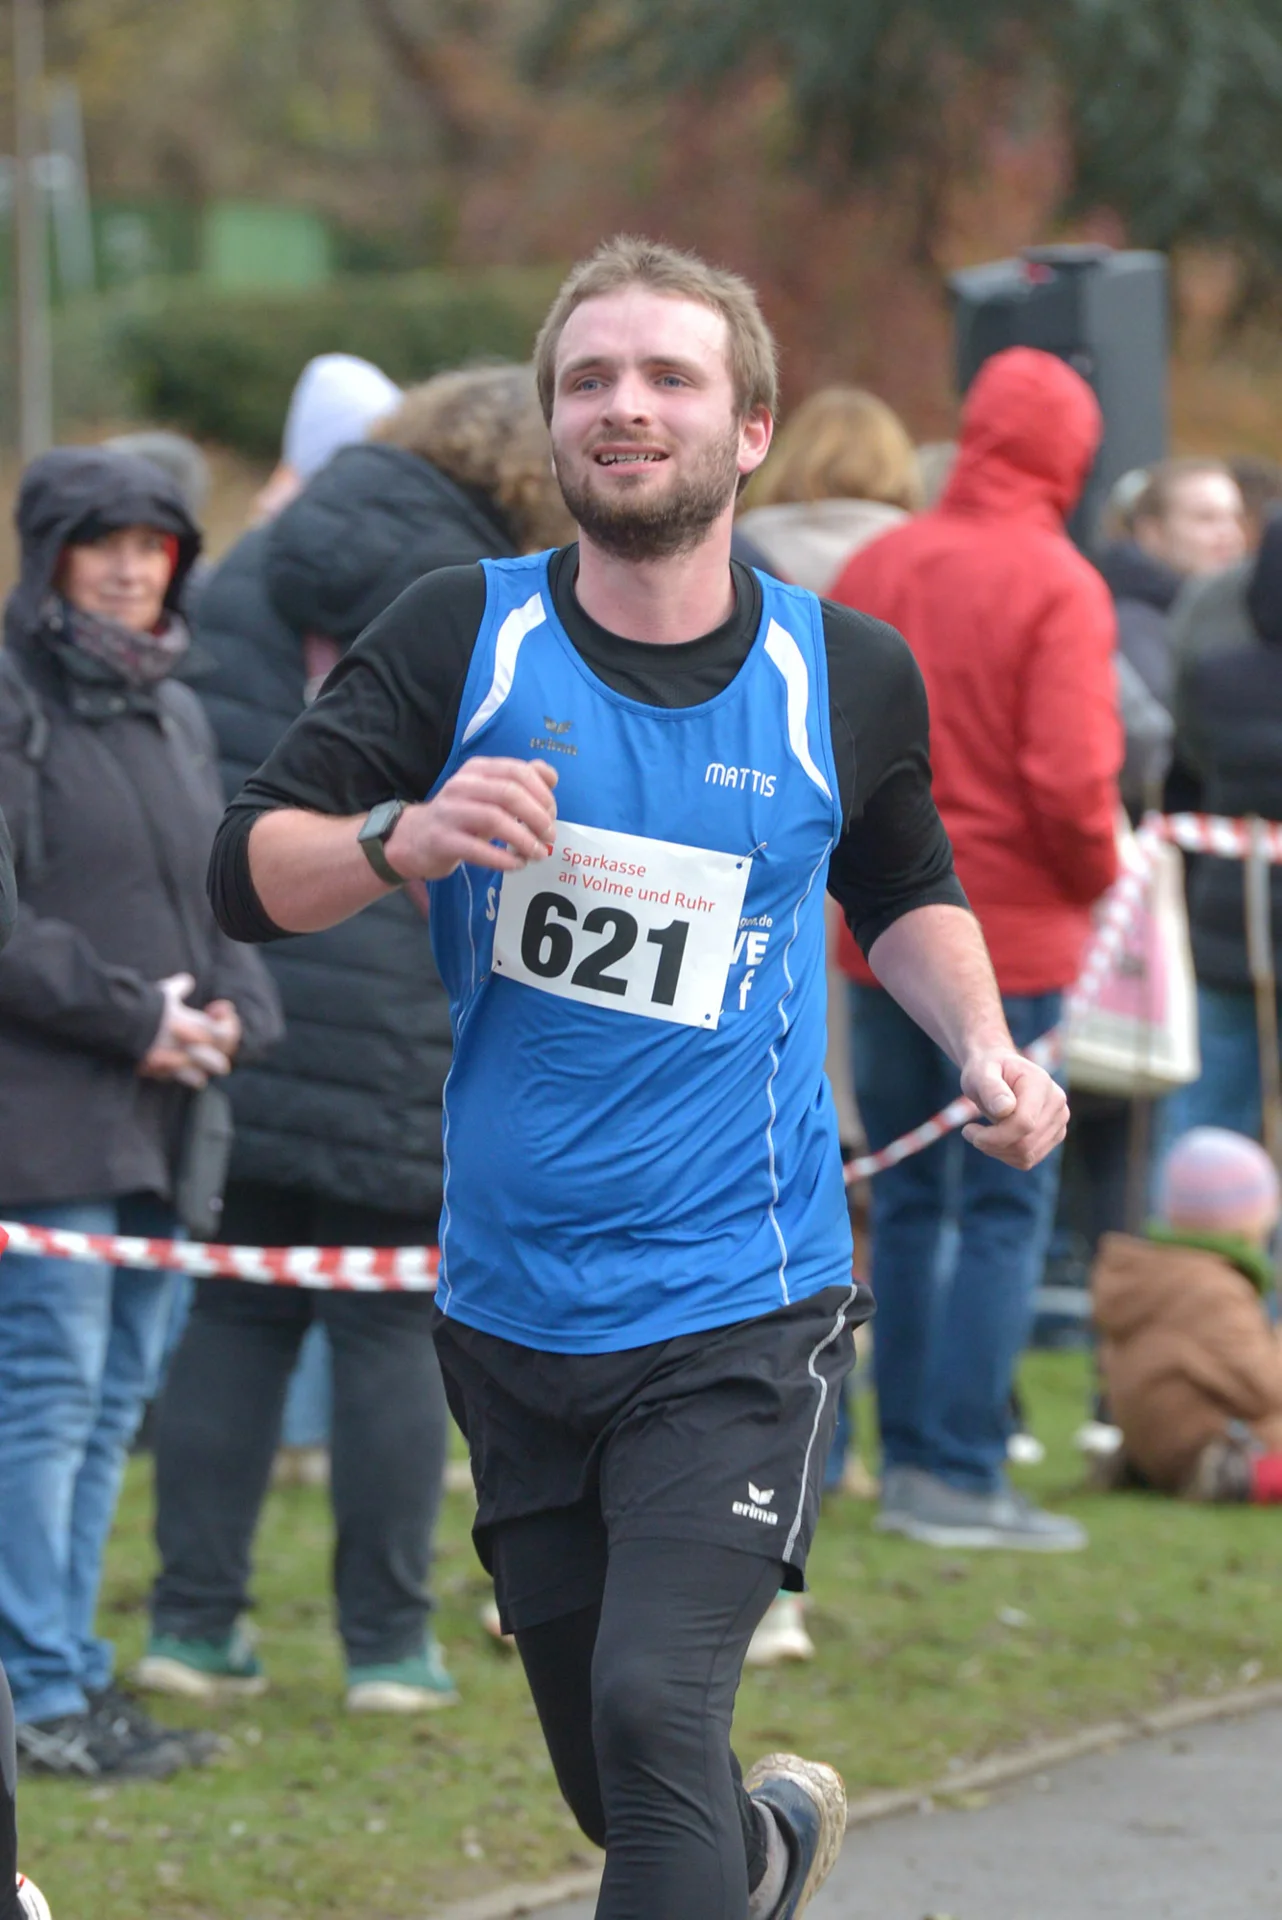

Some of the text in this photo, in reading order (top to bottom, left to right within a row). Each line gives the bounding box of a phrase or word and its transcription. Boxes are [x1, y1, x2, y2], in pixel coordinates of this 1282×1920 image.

[704, 762, 777, 798] MATTIS
[562, 847, 647, 877] Sparkasse
[558, 871, 716, 914] an Volme und Ruhr
[520, 891, 690, 1007] 621
[732, 1501, 778, 1526] erima
